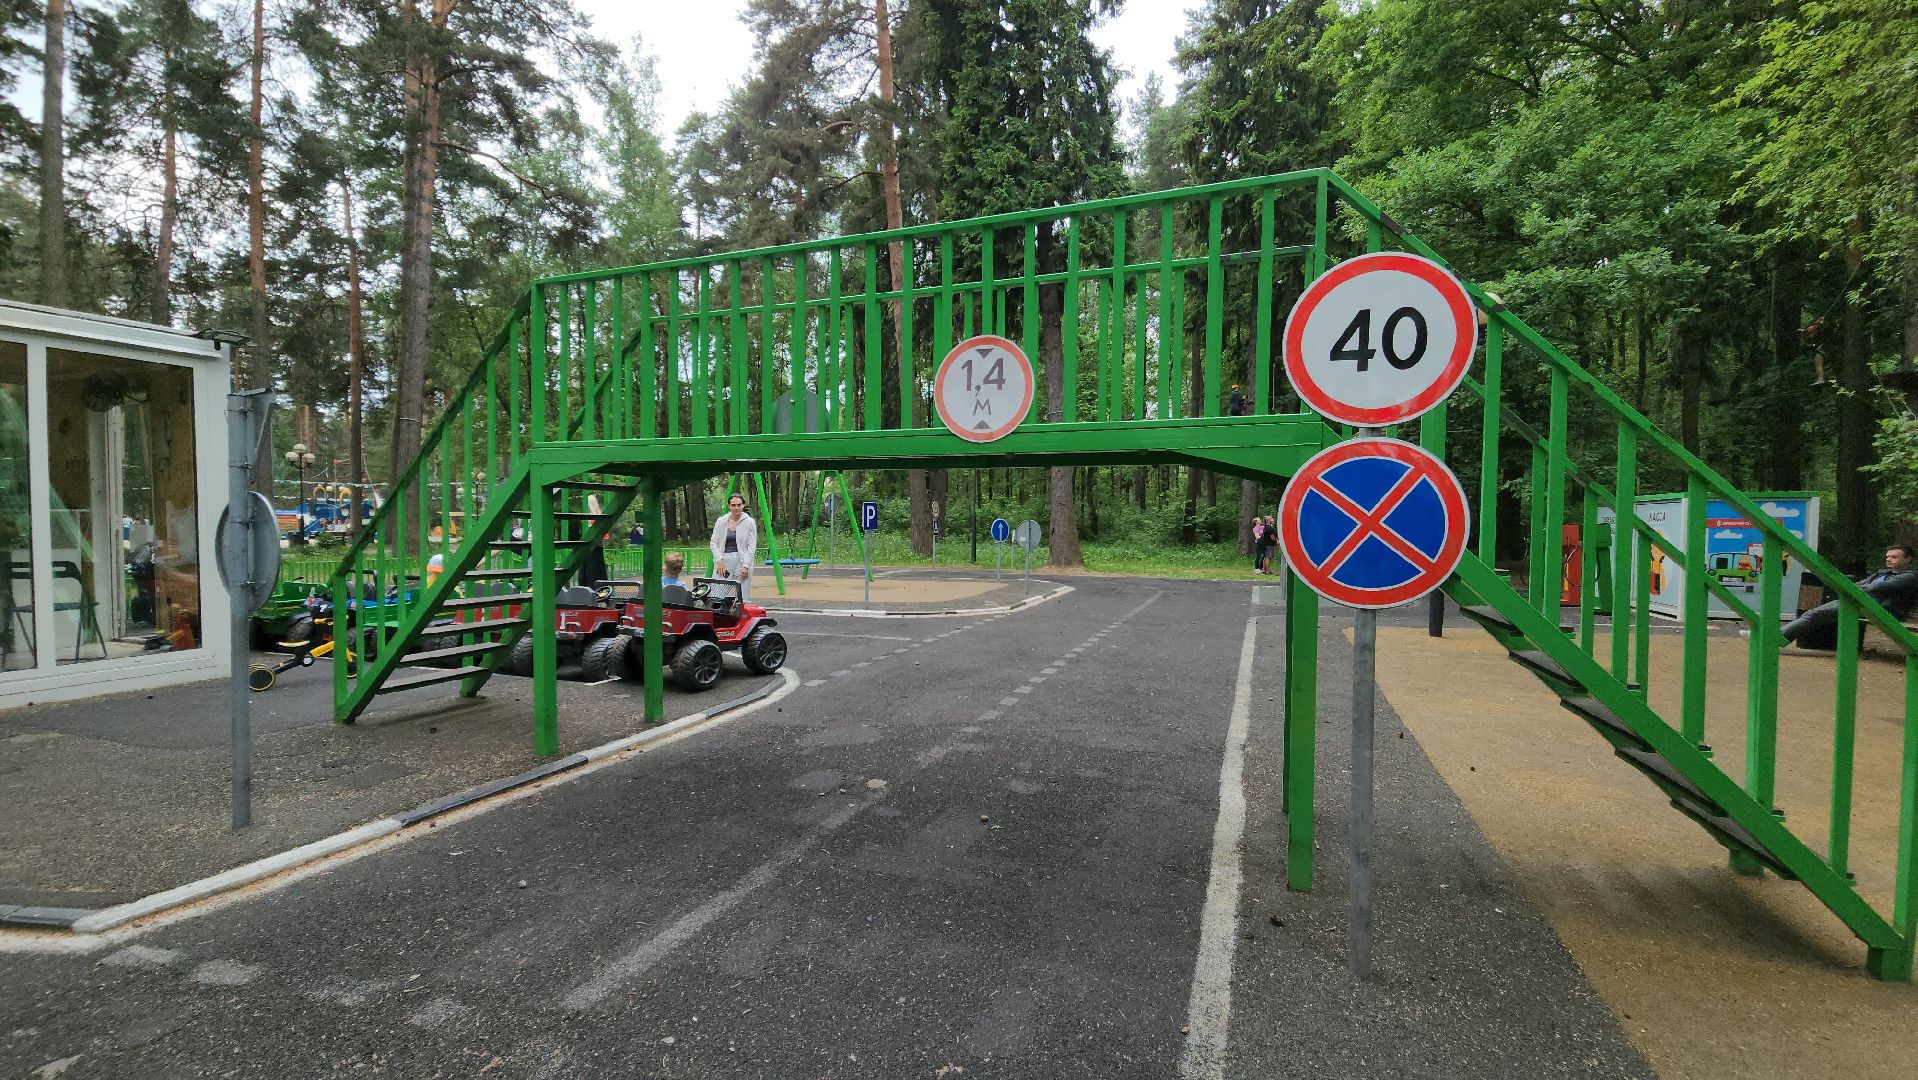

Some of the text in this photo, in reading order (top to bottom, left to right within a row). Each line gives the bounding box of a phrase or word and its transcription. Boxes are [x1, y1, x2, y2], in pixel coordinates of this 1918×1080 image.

[1329, 305, 1429, 373] 40
[960, 357, 1007, 397] 1,4
[973, 398, 992, 417] М
[866, 505, 876, 528] P
[1648, 511, 1666, 523] КАССА
